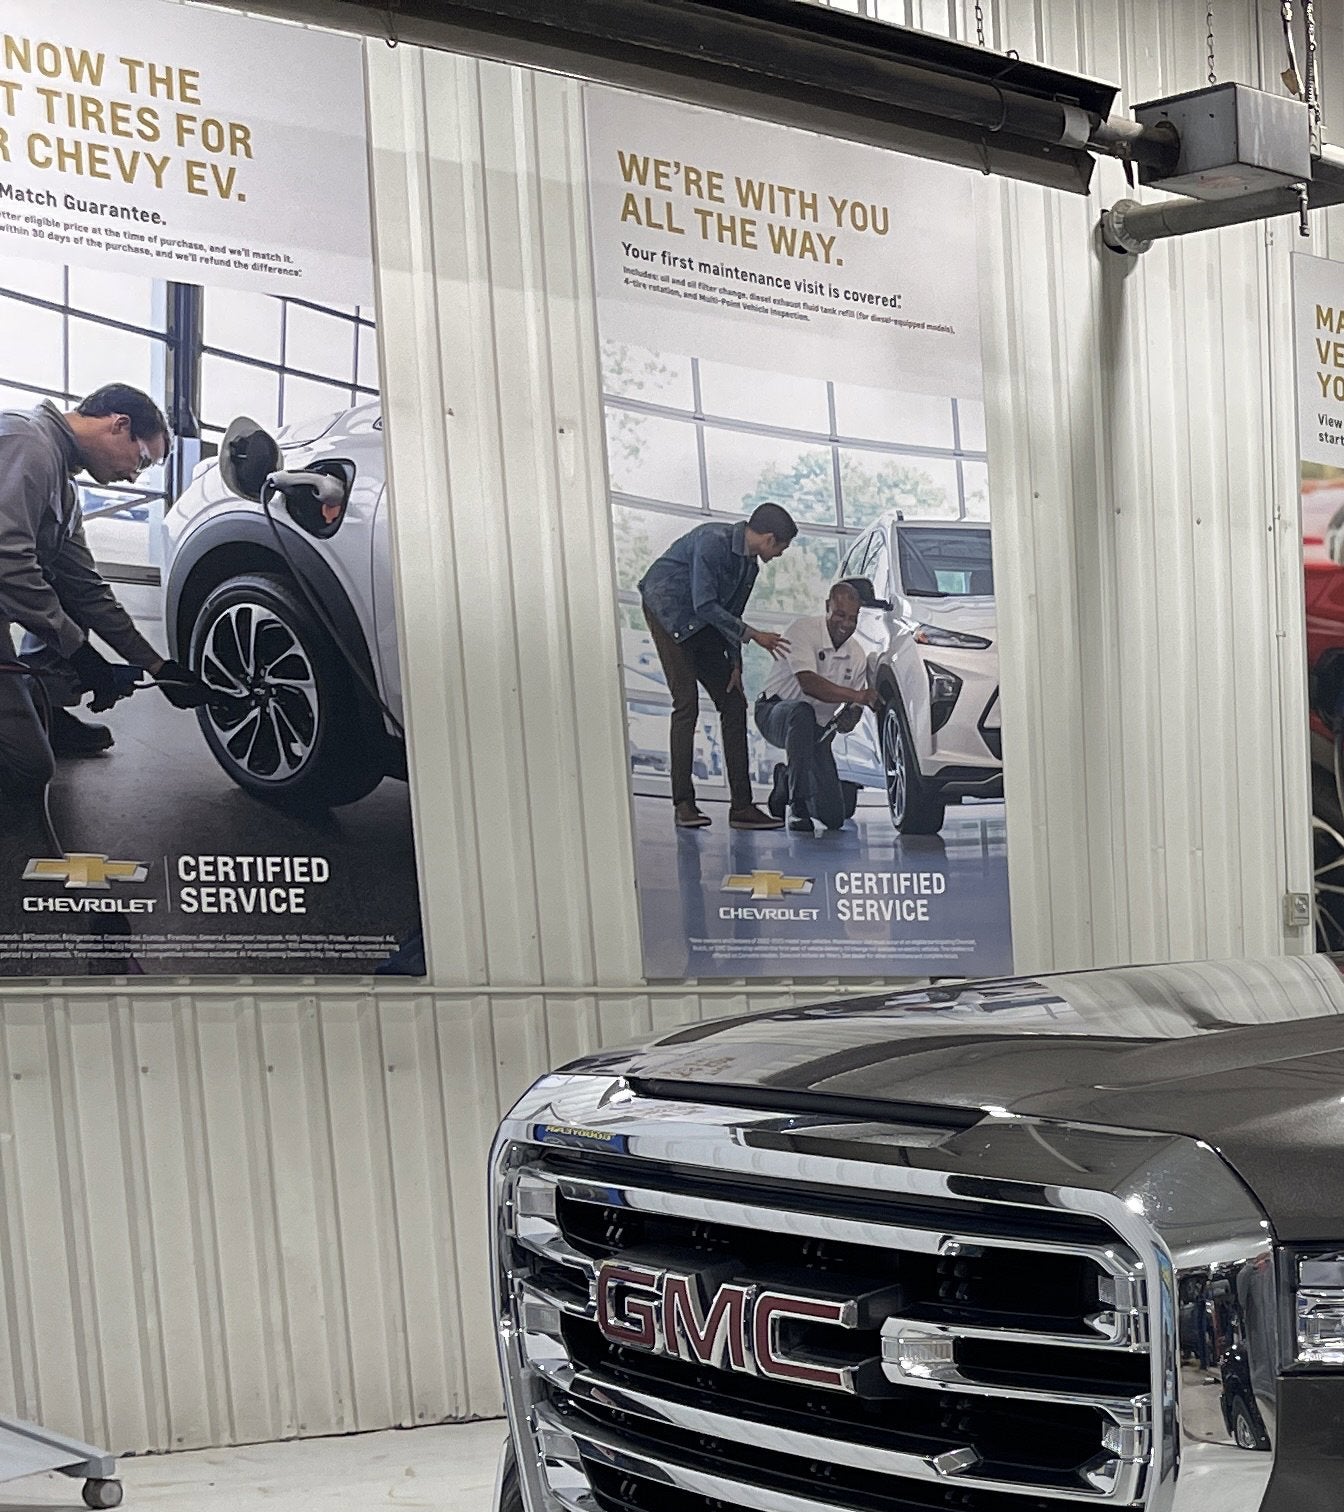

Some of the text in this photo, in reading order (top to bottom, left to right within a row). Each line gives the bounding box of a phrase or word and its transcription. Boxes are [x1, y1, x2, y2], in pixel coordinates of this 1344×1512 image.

[4, 34, 201, 105] NOW THE
[36, 87, 161, 143] TIRES
[175, 112, 254, 160] FOR
[27, 132, 171, 190] CHEVY
[186, 159, 247, 202] EV.
[0, 182, 167, 226] Match Guarantee.
[617, 150, 890, 236] WE'RE WITH YOU
[0, 210, 294, 264] tter eligible price at the time of purchase, and we'll match it.
[32, 228, 44, 239] 30
[48, 231, 71, 244] days
[74, 235, 83, 245] of
[86, 238, 102, 248] the
[105, 241, 154, 258] purchase,
[156, 249, 173, 259] and
[175, 252, 197, 262] we'll
[200, 255, 231, 267] refund
[233, 260, 249, 270] the
[620, 192, 844, 266] ALL THE WAY.
[622, 241, 657, 262] Your
[661, 250, 694, 271] first
[699, 261, 791, 290] maintenance
[794, 278, 824, 296] visit
[828, 283, 840, 299] is
[671, 277, 686, 287] and
[820, 305, 836, 316] tank
[683, 291, 698, 301] and
[1318, 413, 1343, 429] View
[177, 855, 330, 884] CERTIFIED
[834, 872, 946, 896] CERTIFIED
[22, 896, 158, 914] CHEVROLET
[180, 887, 308, 914] SERVICE
[718, 906, 822, 922] CHEVROLET
[836, 899, 930, 922] SERVICE
[598, 1260, 859, 1395] GMC
